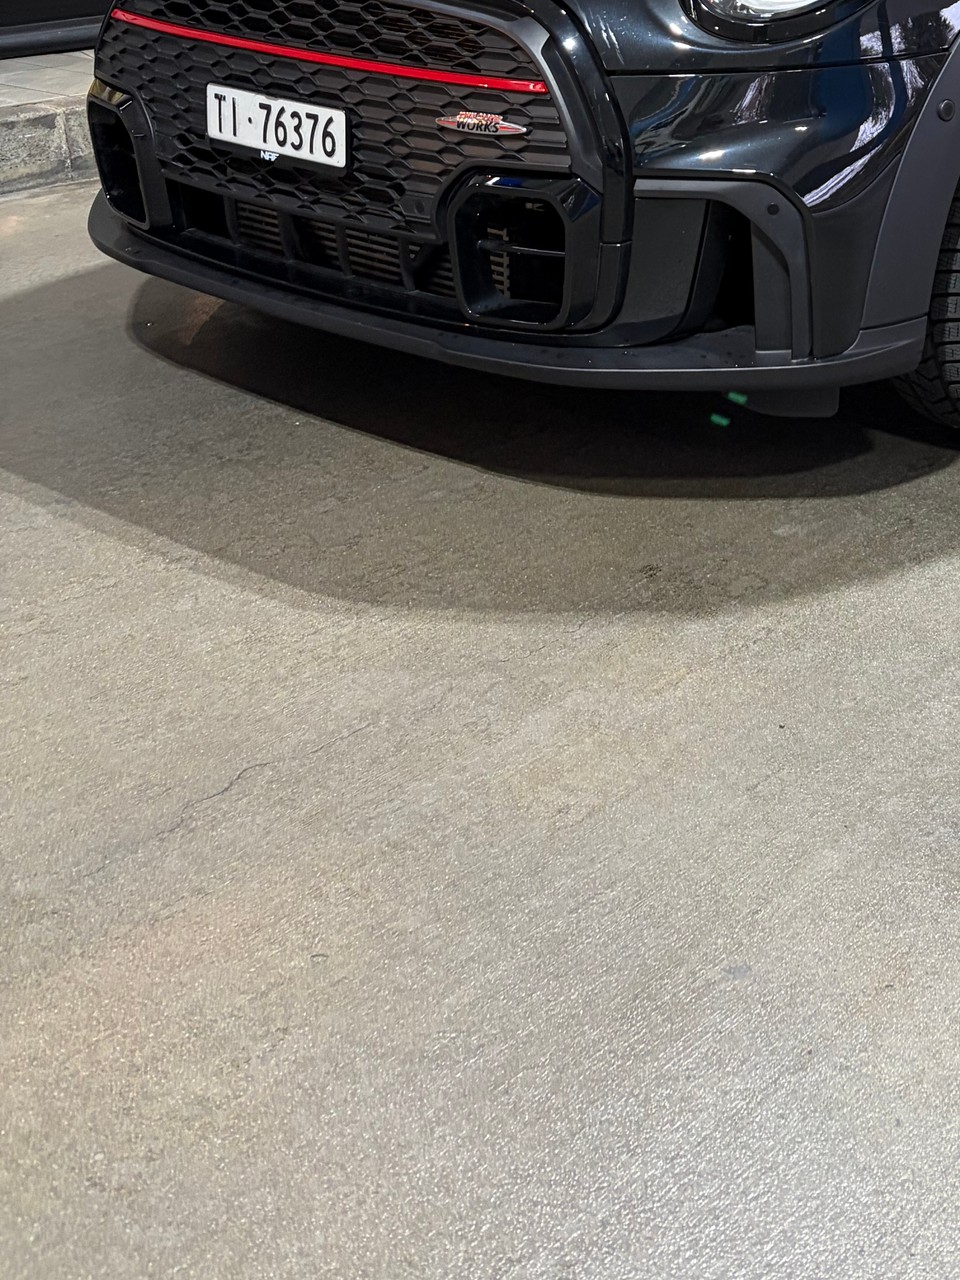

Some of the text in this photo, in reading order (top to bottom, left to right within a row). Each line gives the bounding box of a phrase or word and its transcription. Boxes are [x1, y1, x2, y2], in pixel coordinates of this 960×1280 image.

[214, 93, 336, 158] TI 76376
[456, 120, 500, 133] WORKS
